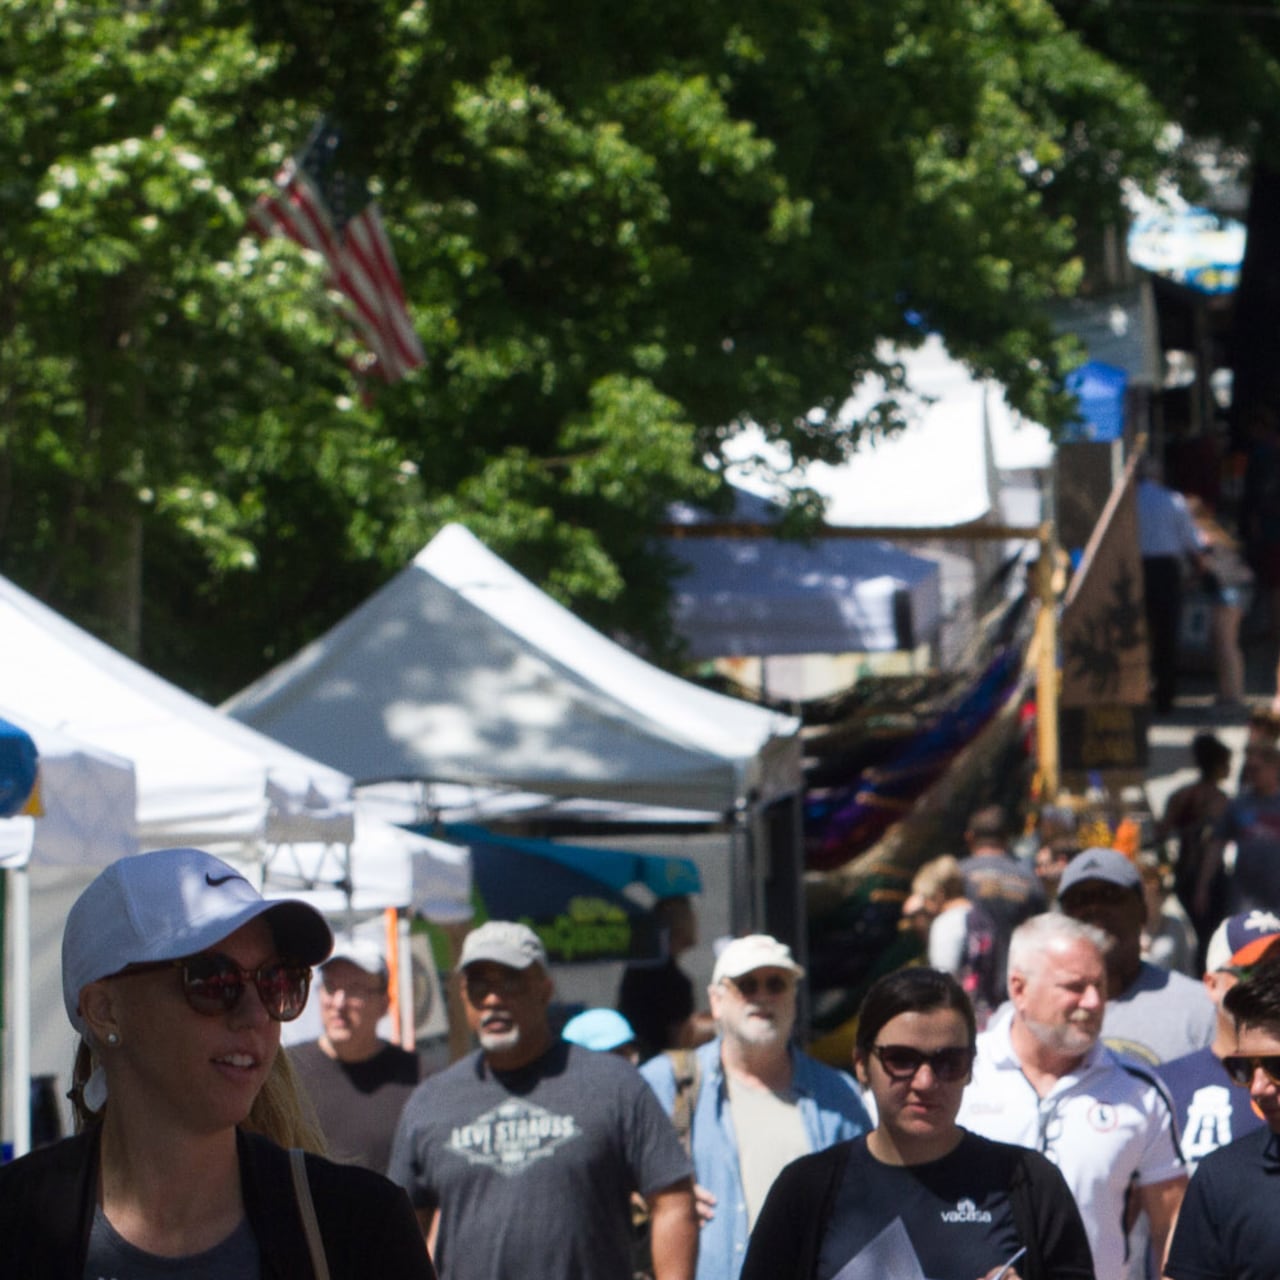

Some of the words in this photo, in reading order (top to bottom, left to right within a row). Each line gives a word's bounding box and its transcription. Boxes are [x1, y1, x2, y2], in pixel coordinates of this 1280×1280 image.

[451, 1123, 491, 1155] LEVI
[494, 1115, 575, 1142] STRAUSS
[941, 1210, 992, 1223] vacasa
